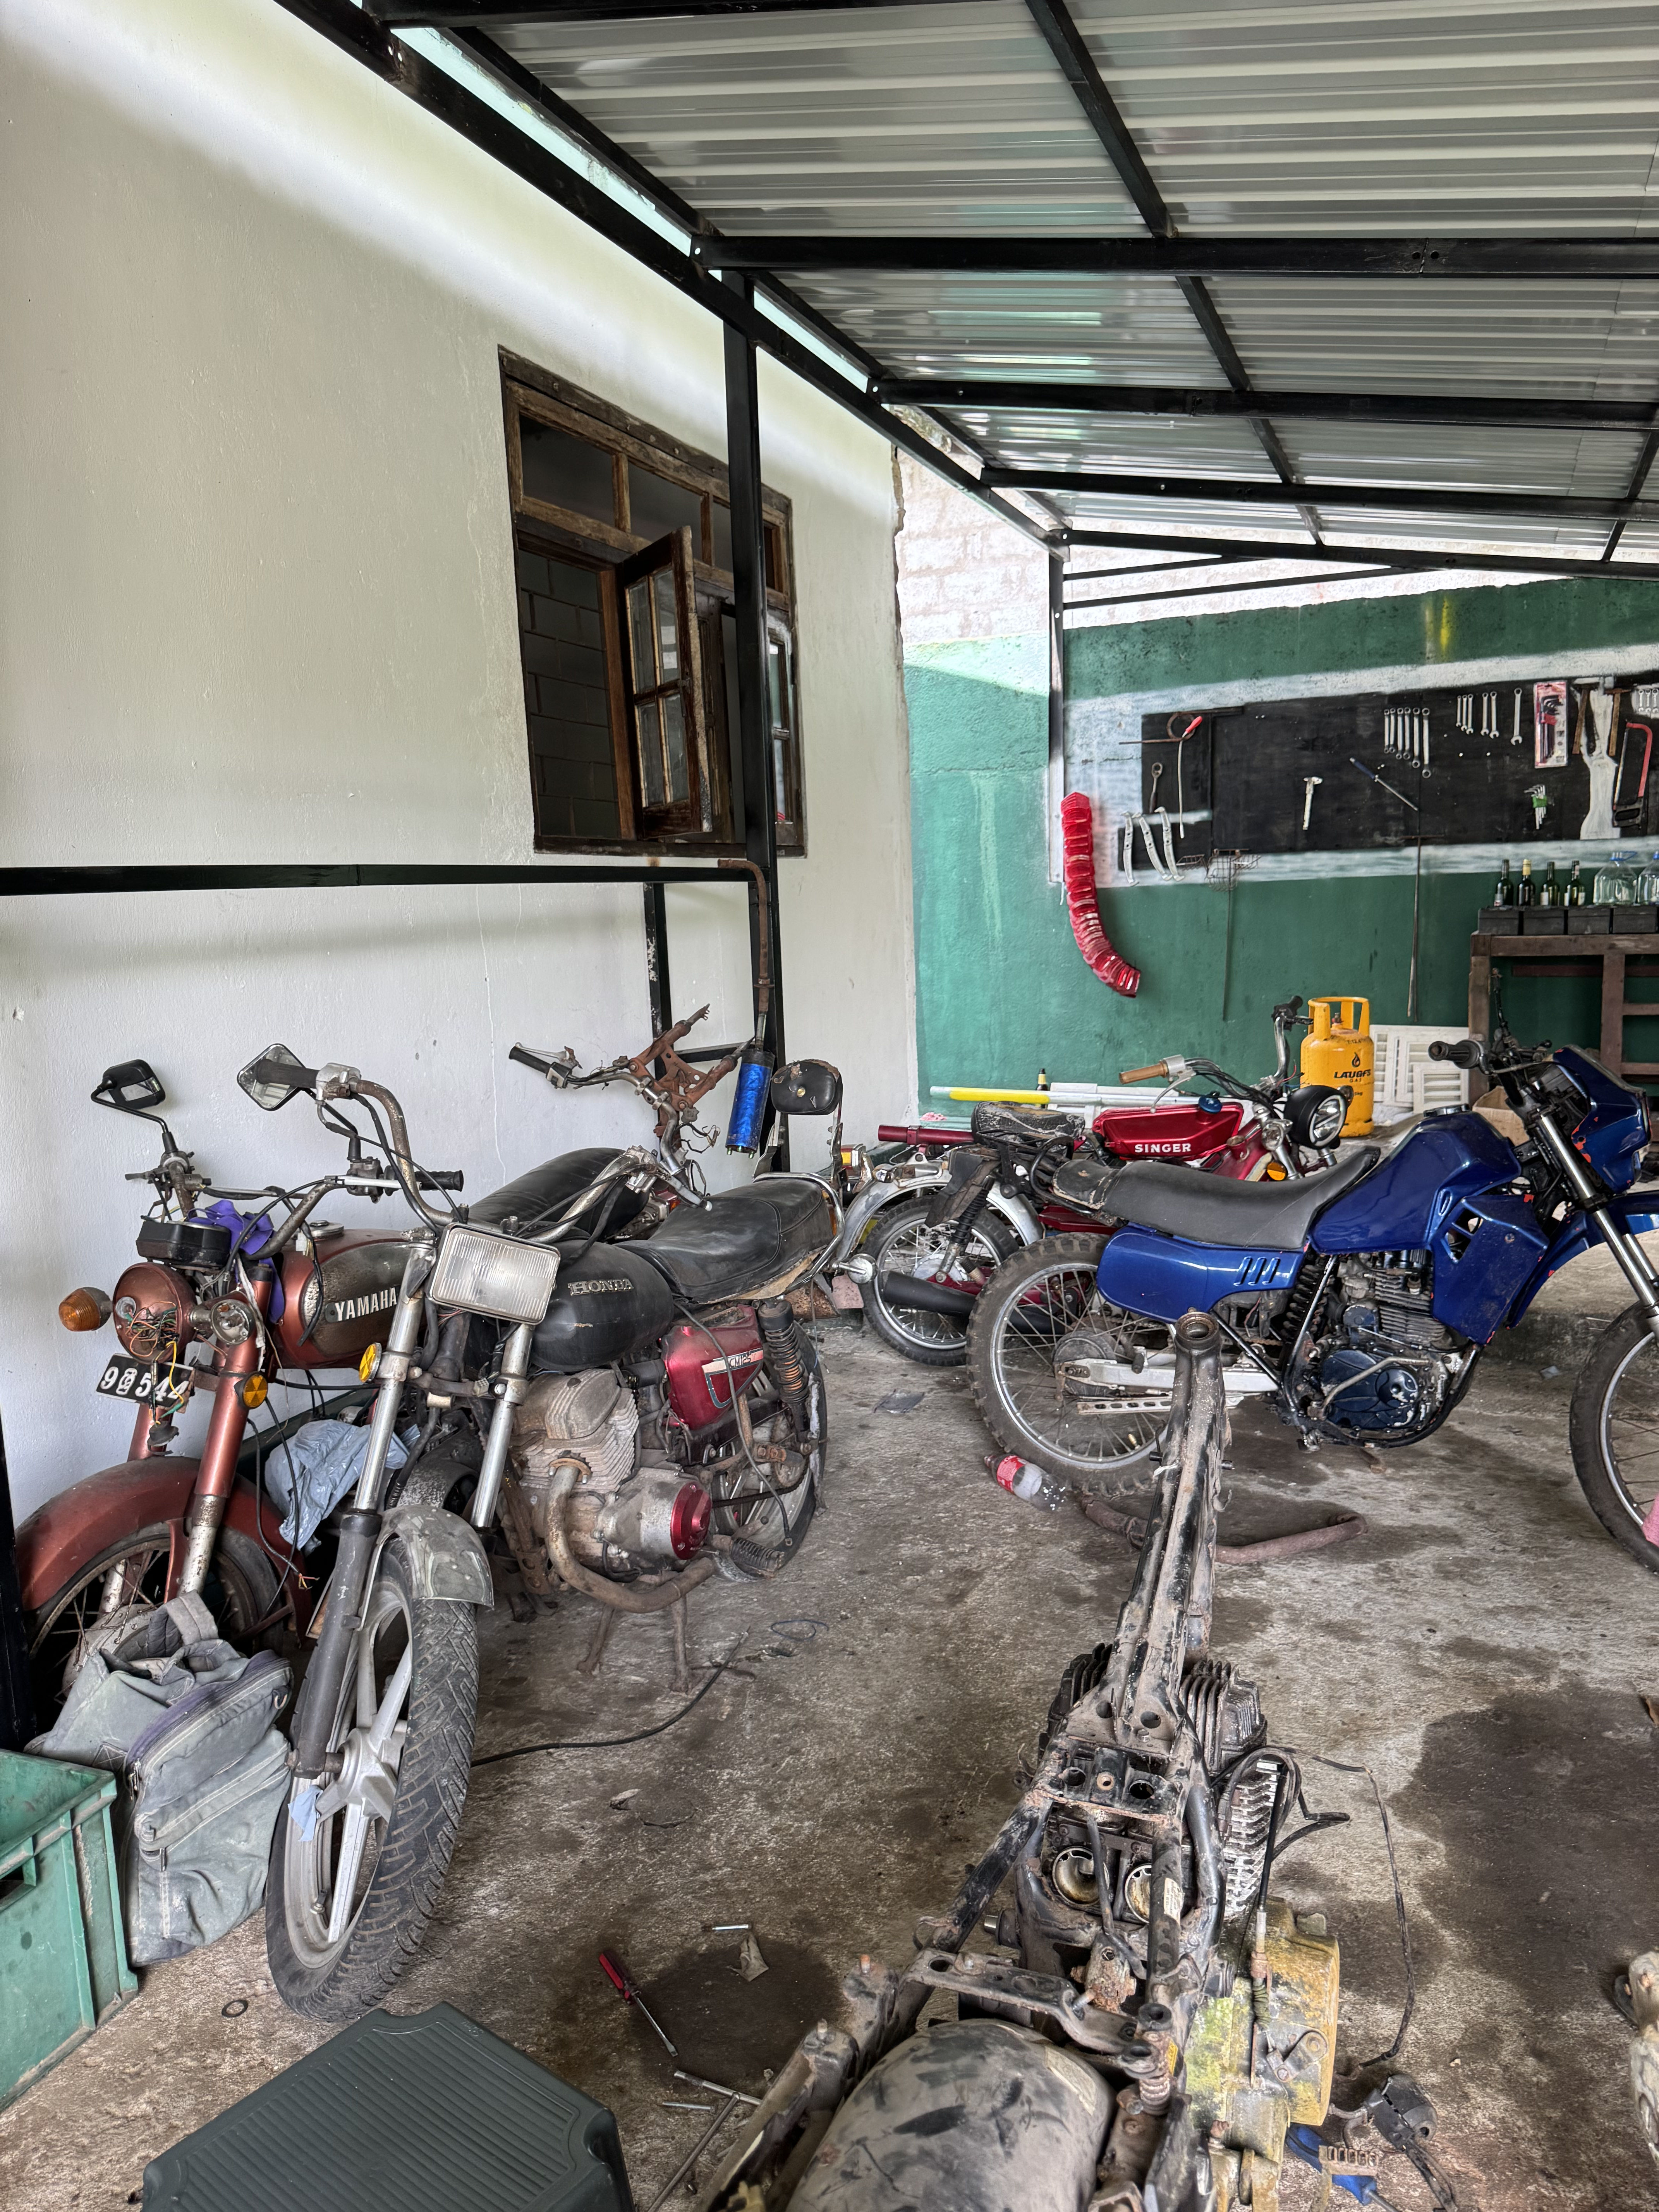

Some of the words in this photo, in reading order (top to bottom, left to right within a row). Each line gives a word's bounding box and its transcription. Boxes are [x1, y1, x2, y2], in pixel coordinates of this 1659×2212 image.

[1334, 1069, 1371, 1079] LAUGFS
[1135, 1143, 1191, 1153] SINGER
[568, 1279, 634, 1296] HONDA
[335, 1287, 397, 1321] YAMAHA
